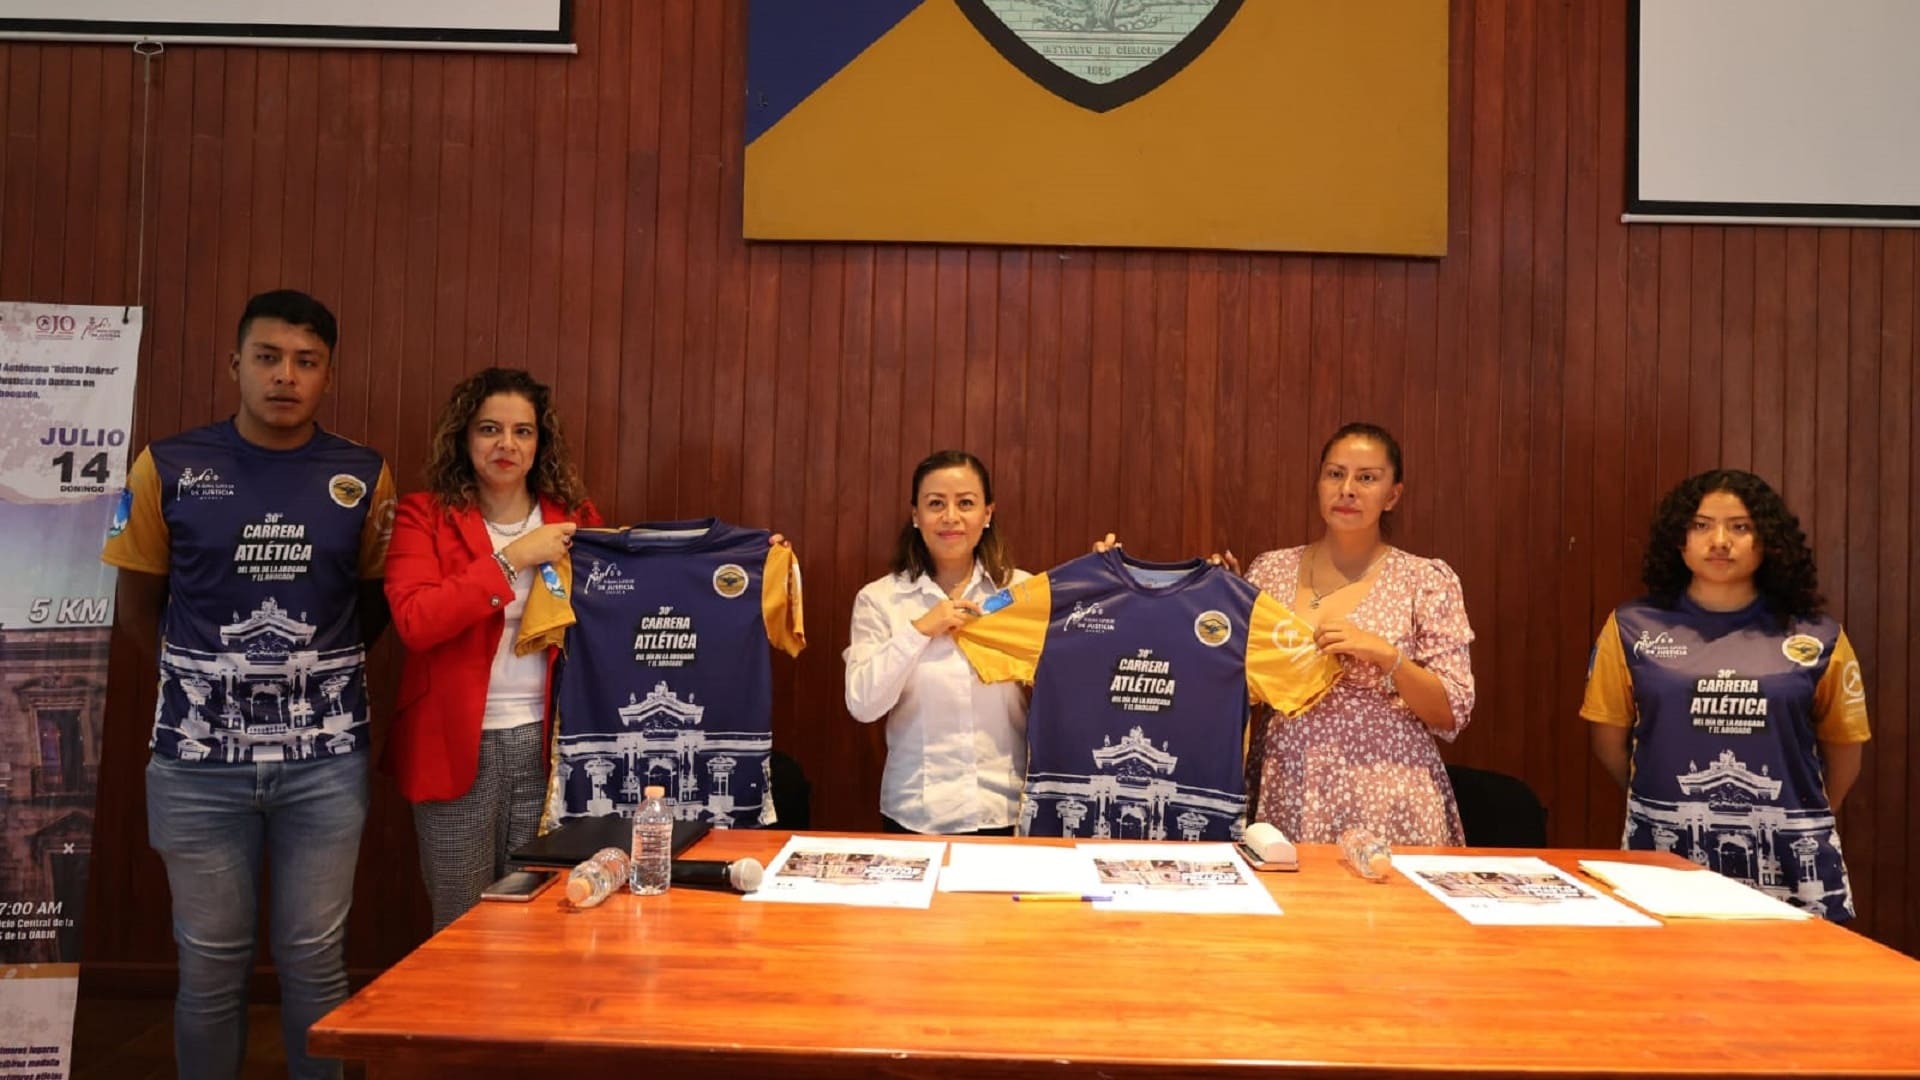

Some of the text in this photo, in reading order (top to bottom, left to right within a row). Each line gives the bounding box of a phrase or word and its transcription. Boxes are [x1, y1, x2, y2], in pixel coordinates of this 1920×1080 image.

[40, 427, 125, 447] JULIO
[52, 451, 110, 484] 14
[60, 485, 105, 493] DOMINGO
[243, 525, 304, 539] CARRERA
[234, 541, 312, 561] ATLÉTICA
[28, 599, 109, 624] 5 KM
[641, 616, 690, 630] CARRERA
[633, 631, 697, 650] ATLÉTICA
[1119, 658, 1170, 675] CARRERA
[1110, 674, 1176, 696] ATLÉTICA
[1697, 679, 1758, 693] CARRERA
[1690, 695, 1768, 716] ATLÉTICA
[36, 901, 63, 915] AM
[17, 919, 52, 928] Central
[52, 919, 64, 928] de
